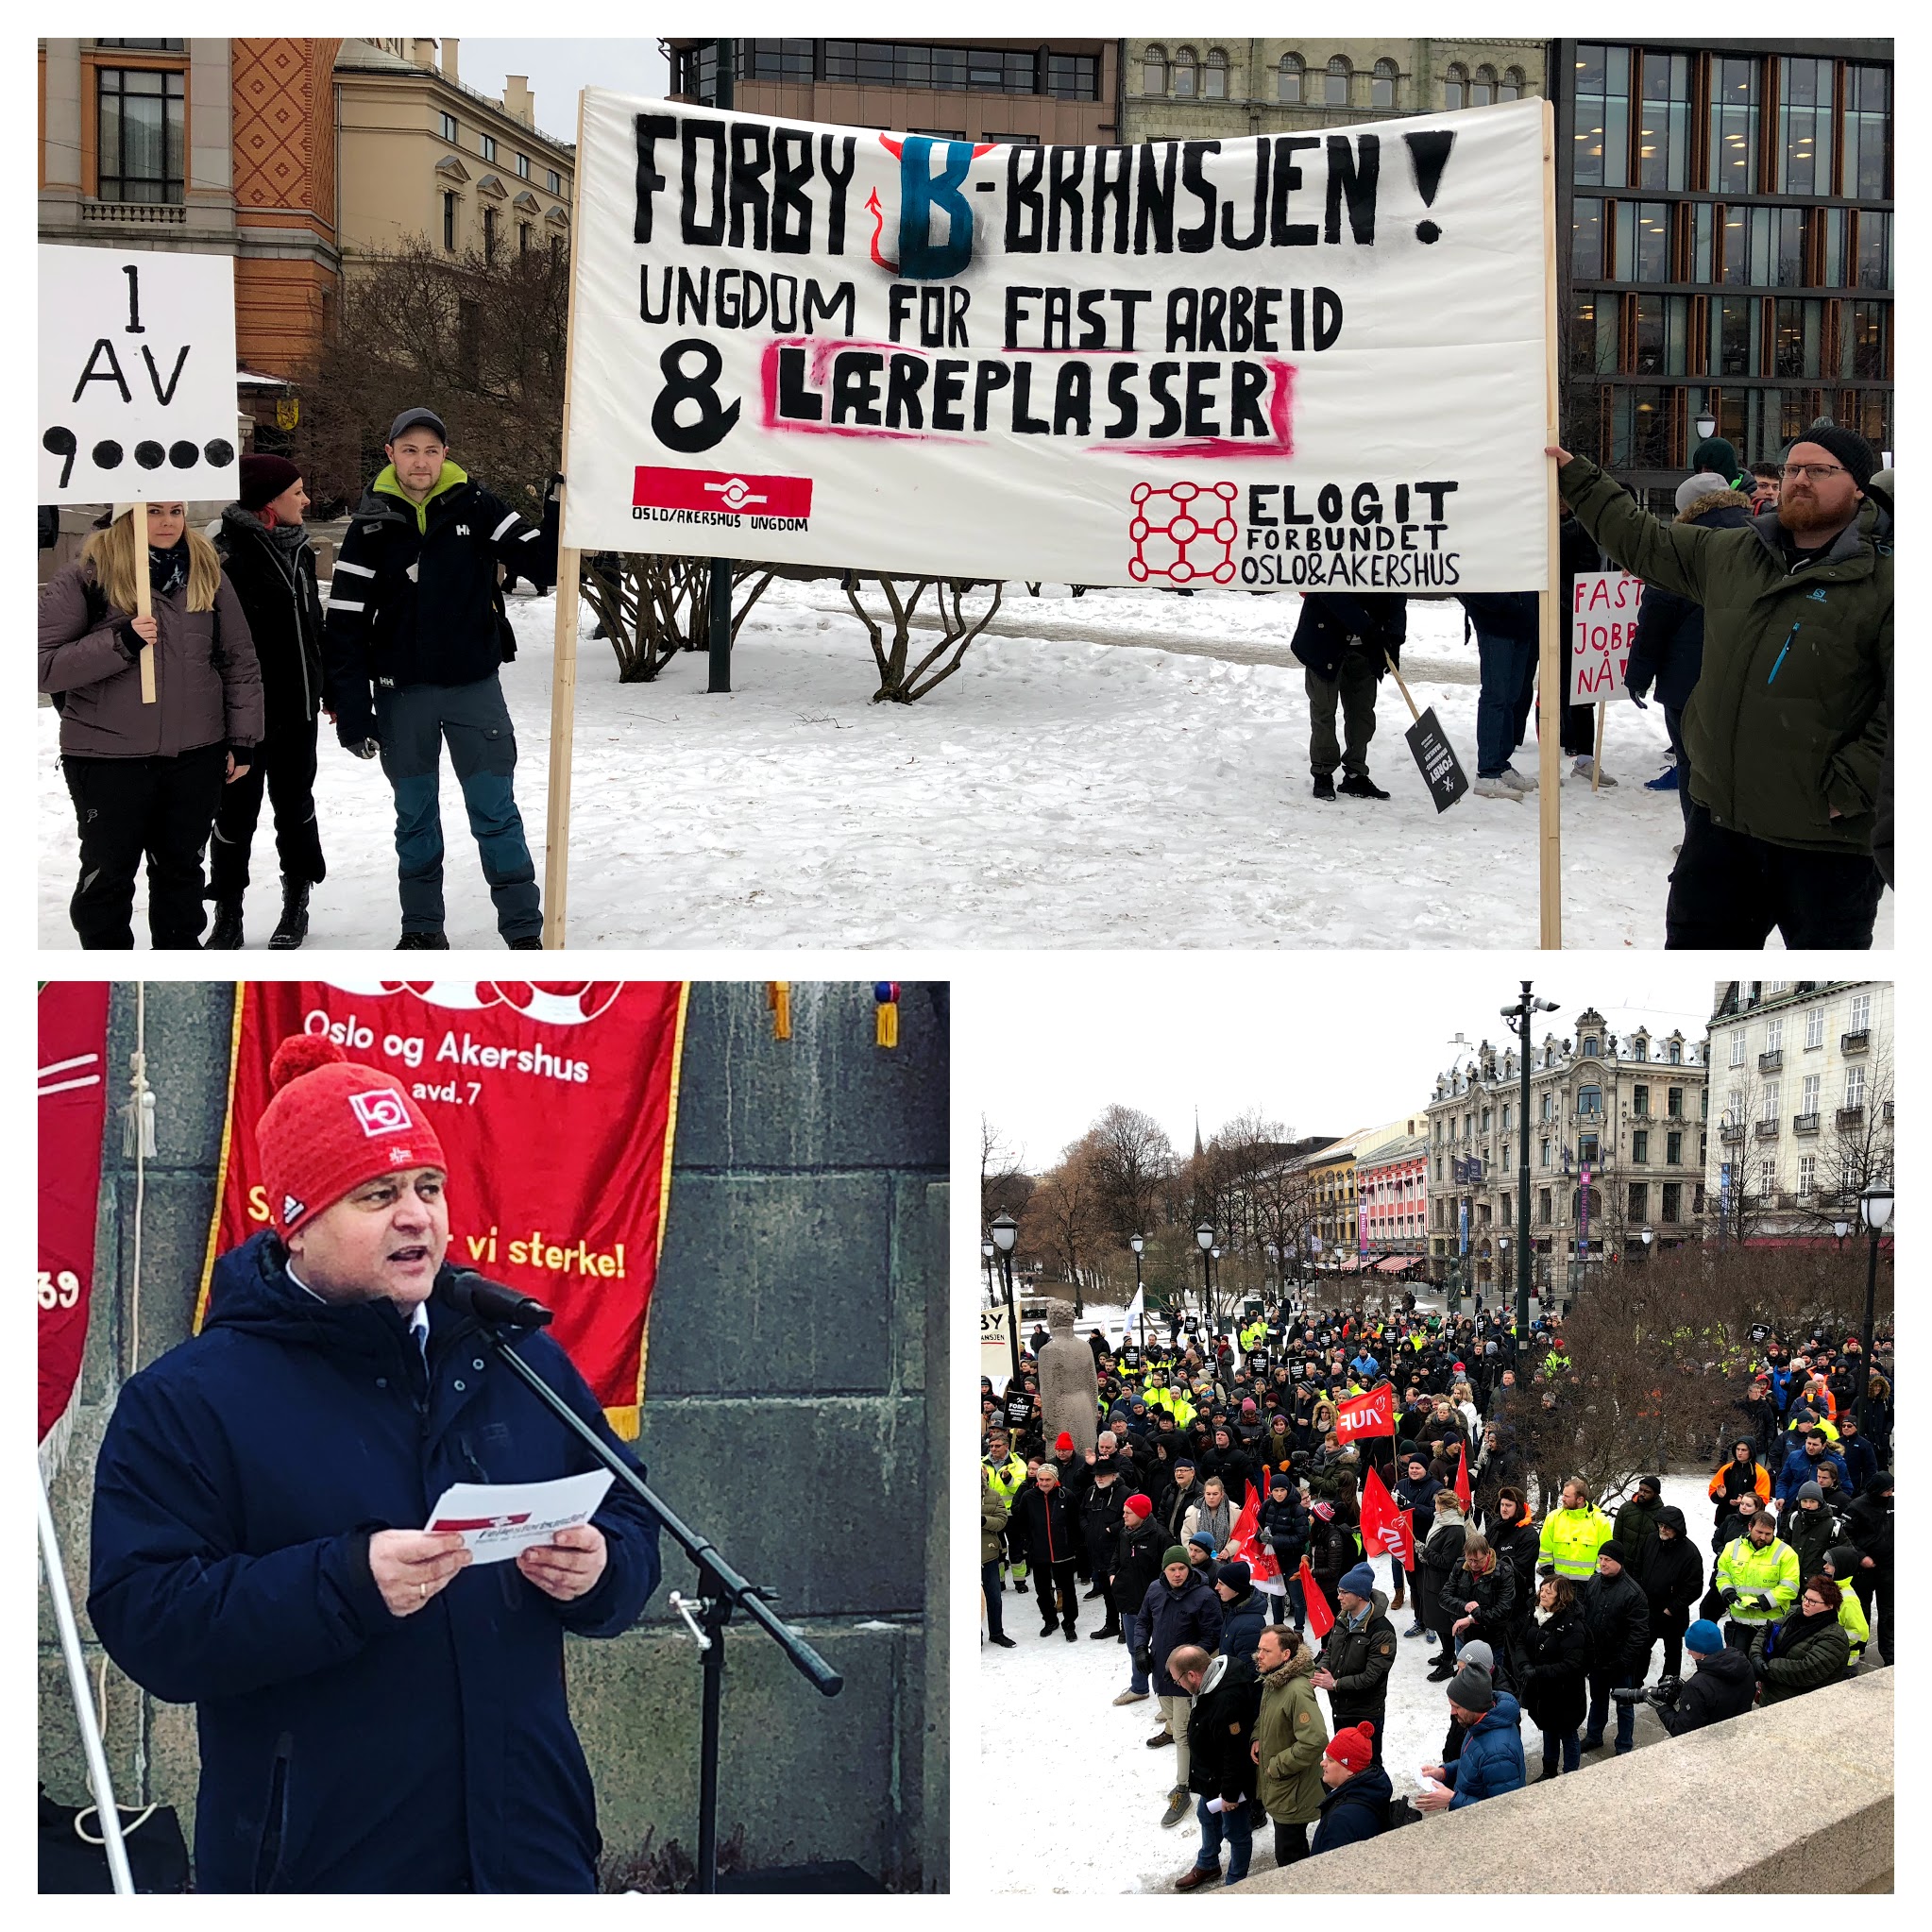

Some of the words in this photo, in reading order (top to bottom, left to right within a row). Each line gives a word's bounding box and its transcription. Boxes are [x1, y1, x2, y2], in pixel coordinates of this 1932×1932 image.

[634, 114, 857, 255] FORBY
[121, 264, 145, 333] 1
[639, 264, 856, 336] UNGDOM
[889, 285, 971, 347] FOR
[1005, 286, 1151, 350] FAST
[1165, 285, 1344, 352] ARBEID
[72, 338, 191, 406] AV
[652, 338, 741, 453] &
[779, 347, 1270, 437] LÆREPLASSER
[632, 506, 741, 528] OSLO/AKERSHUS
[751, 517, 809, 532] UNGDOM
[1246, 524, 1449, 551] FORBUNDET
[1242, 551, 1460, 588] OSLO&AKERSHUS
[1575, 579, 1644, 613] FAST
[1429, 754, 1454, 785] FORBY
[304, 1009, 374, 1048] Oslo
[382, 1032, 424, 1068] og
[435, 1030, 590, 1083] Akershus
[466, 1226, 498, 1263] vi
[508, 1231, 625, 1279] sterke!
[38, 1270, 79, 1311] 39
